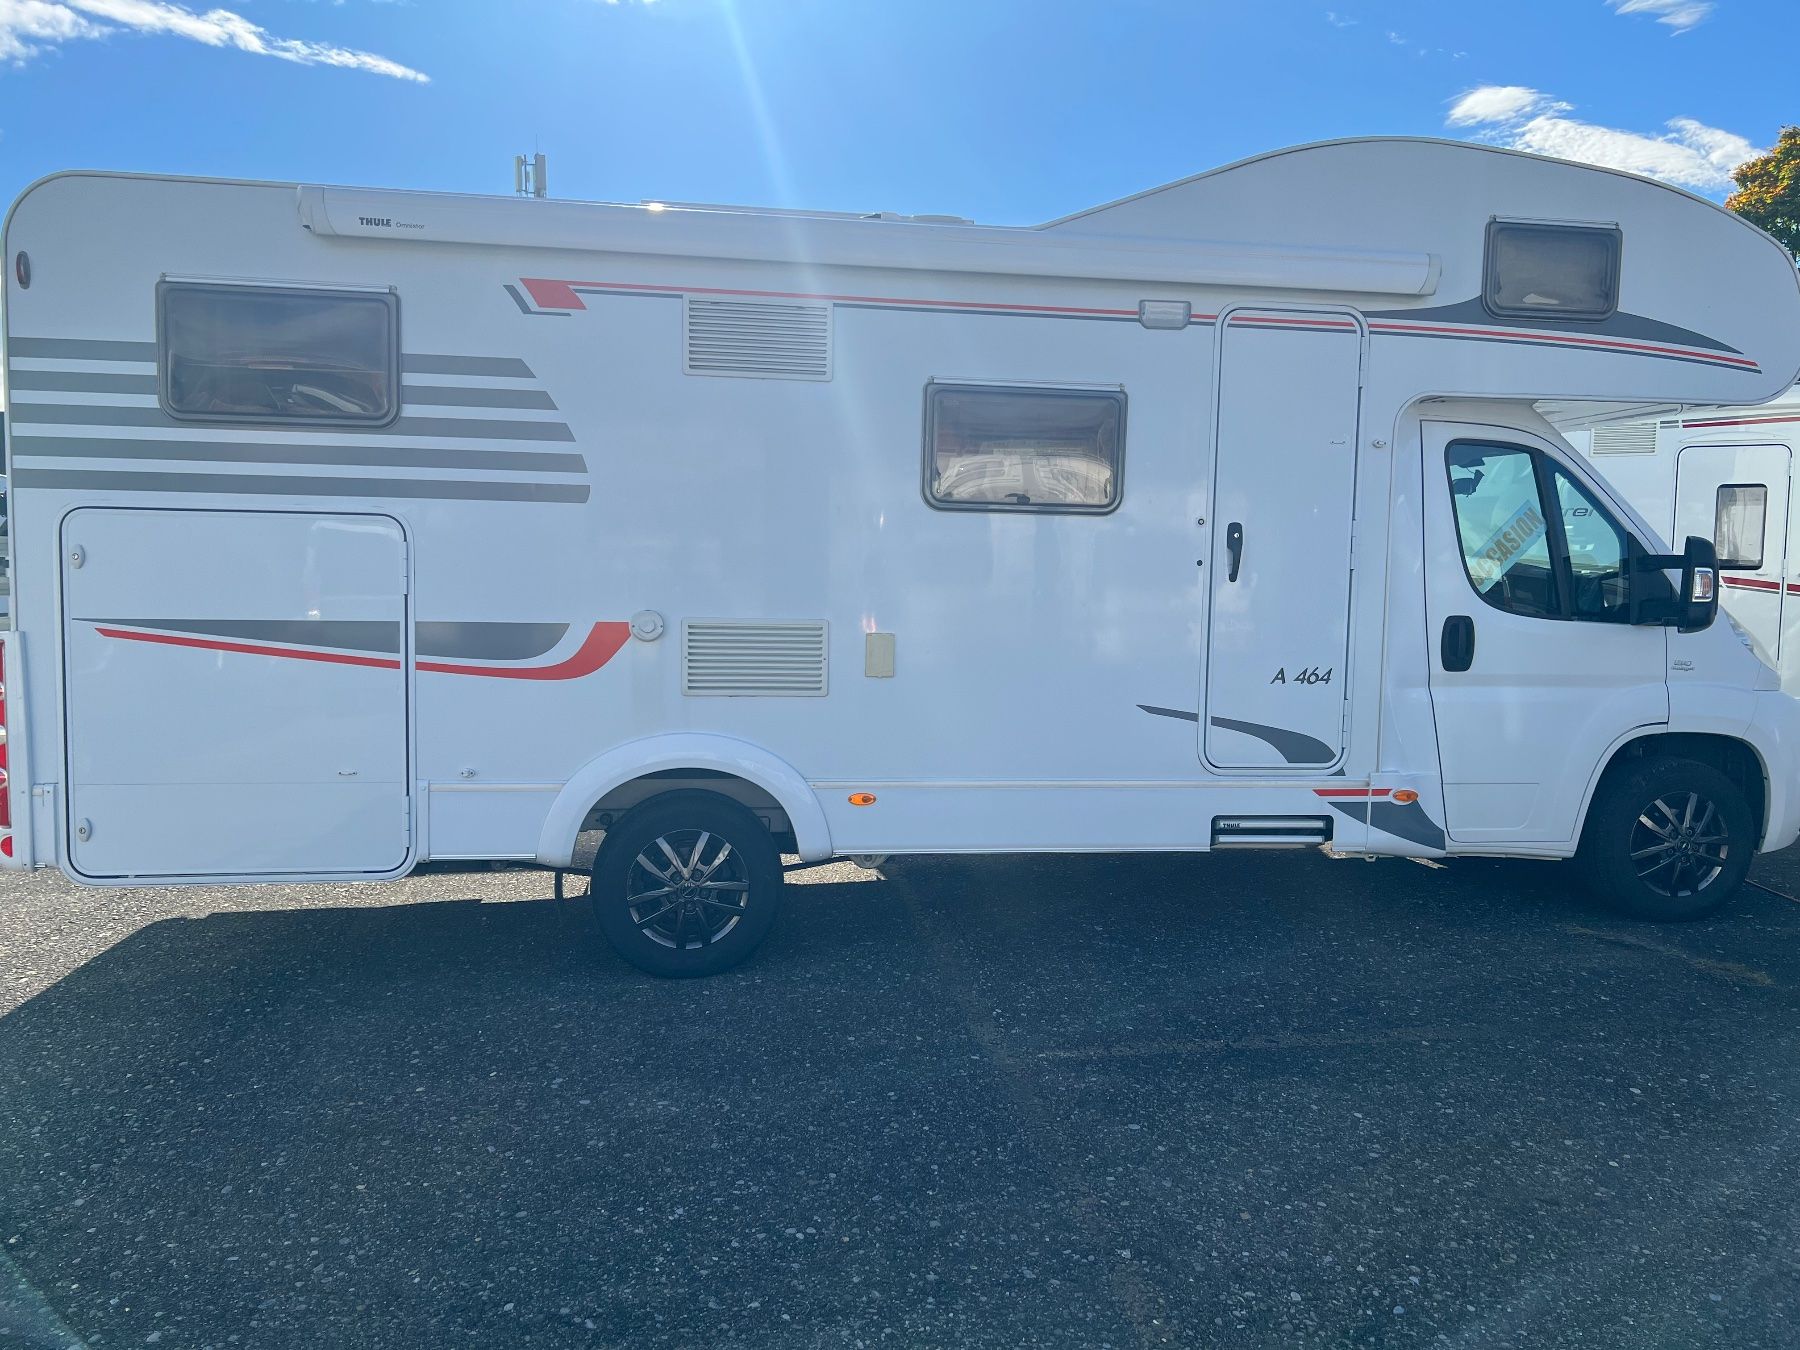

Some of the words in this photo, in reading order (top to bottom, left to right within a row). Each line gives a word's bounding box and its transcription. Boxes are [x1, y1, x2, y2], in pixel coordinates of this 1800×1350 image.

[358, 216, 392, 228] THULE
[1270, 667, 1286, 685] A
[1292, 666, 1333, 685] 464
